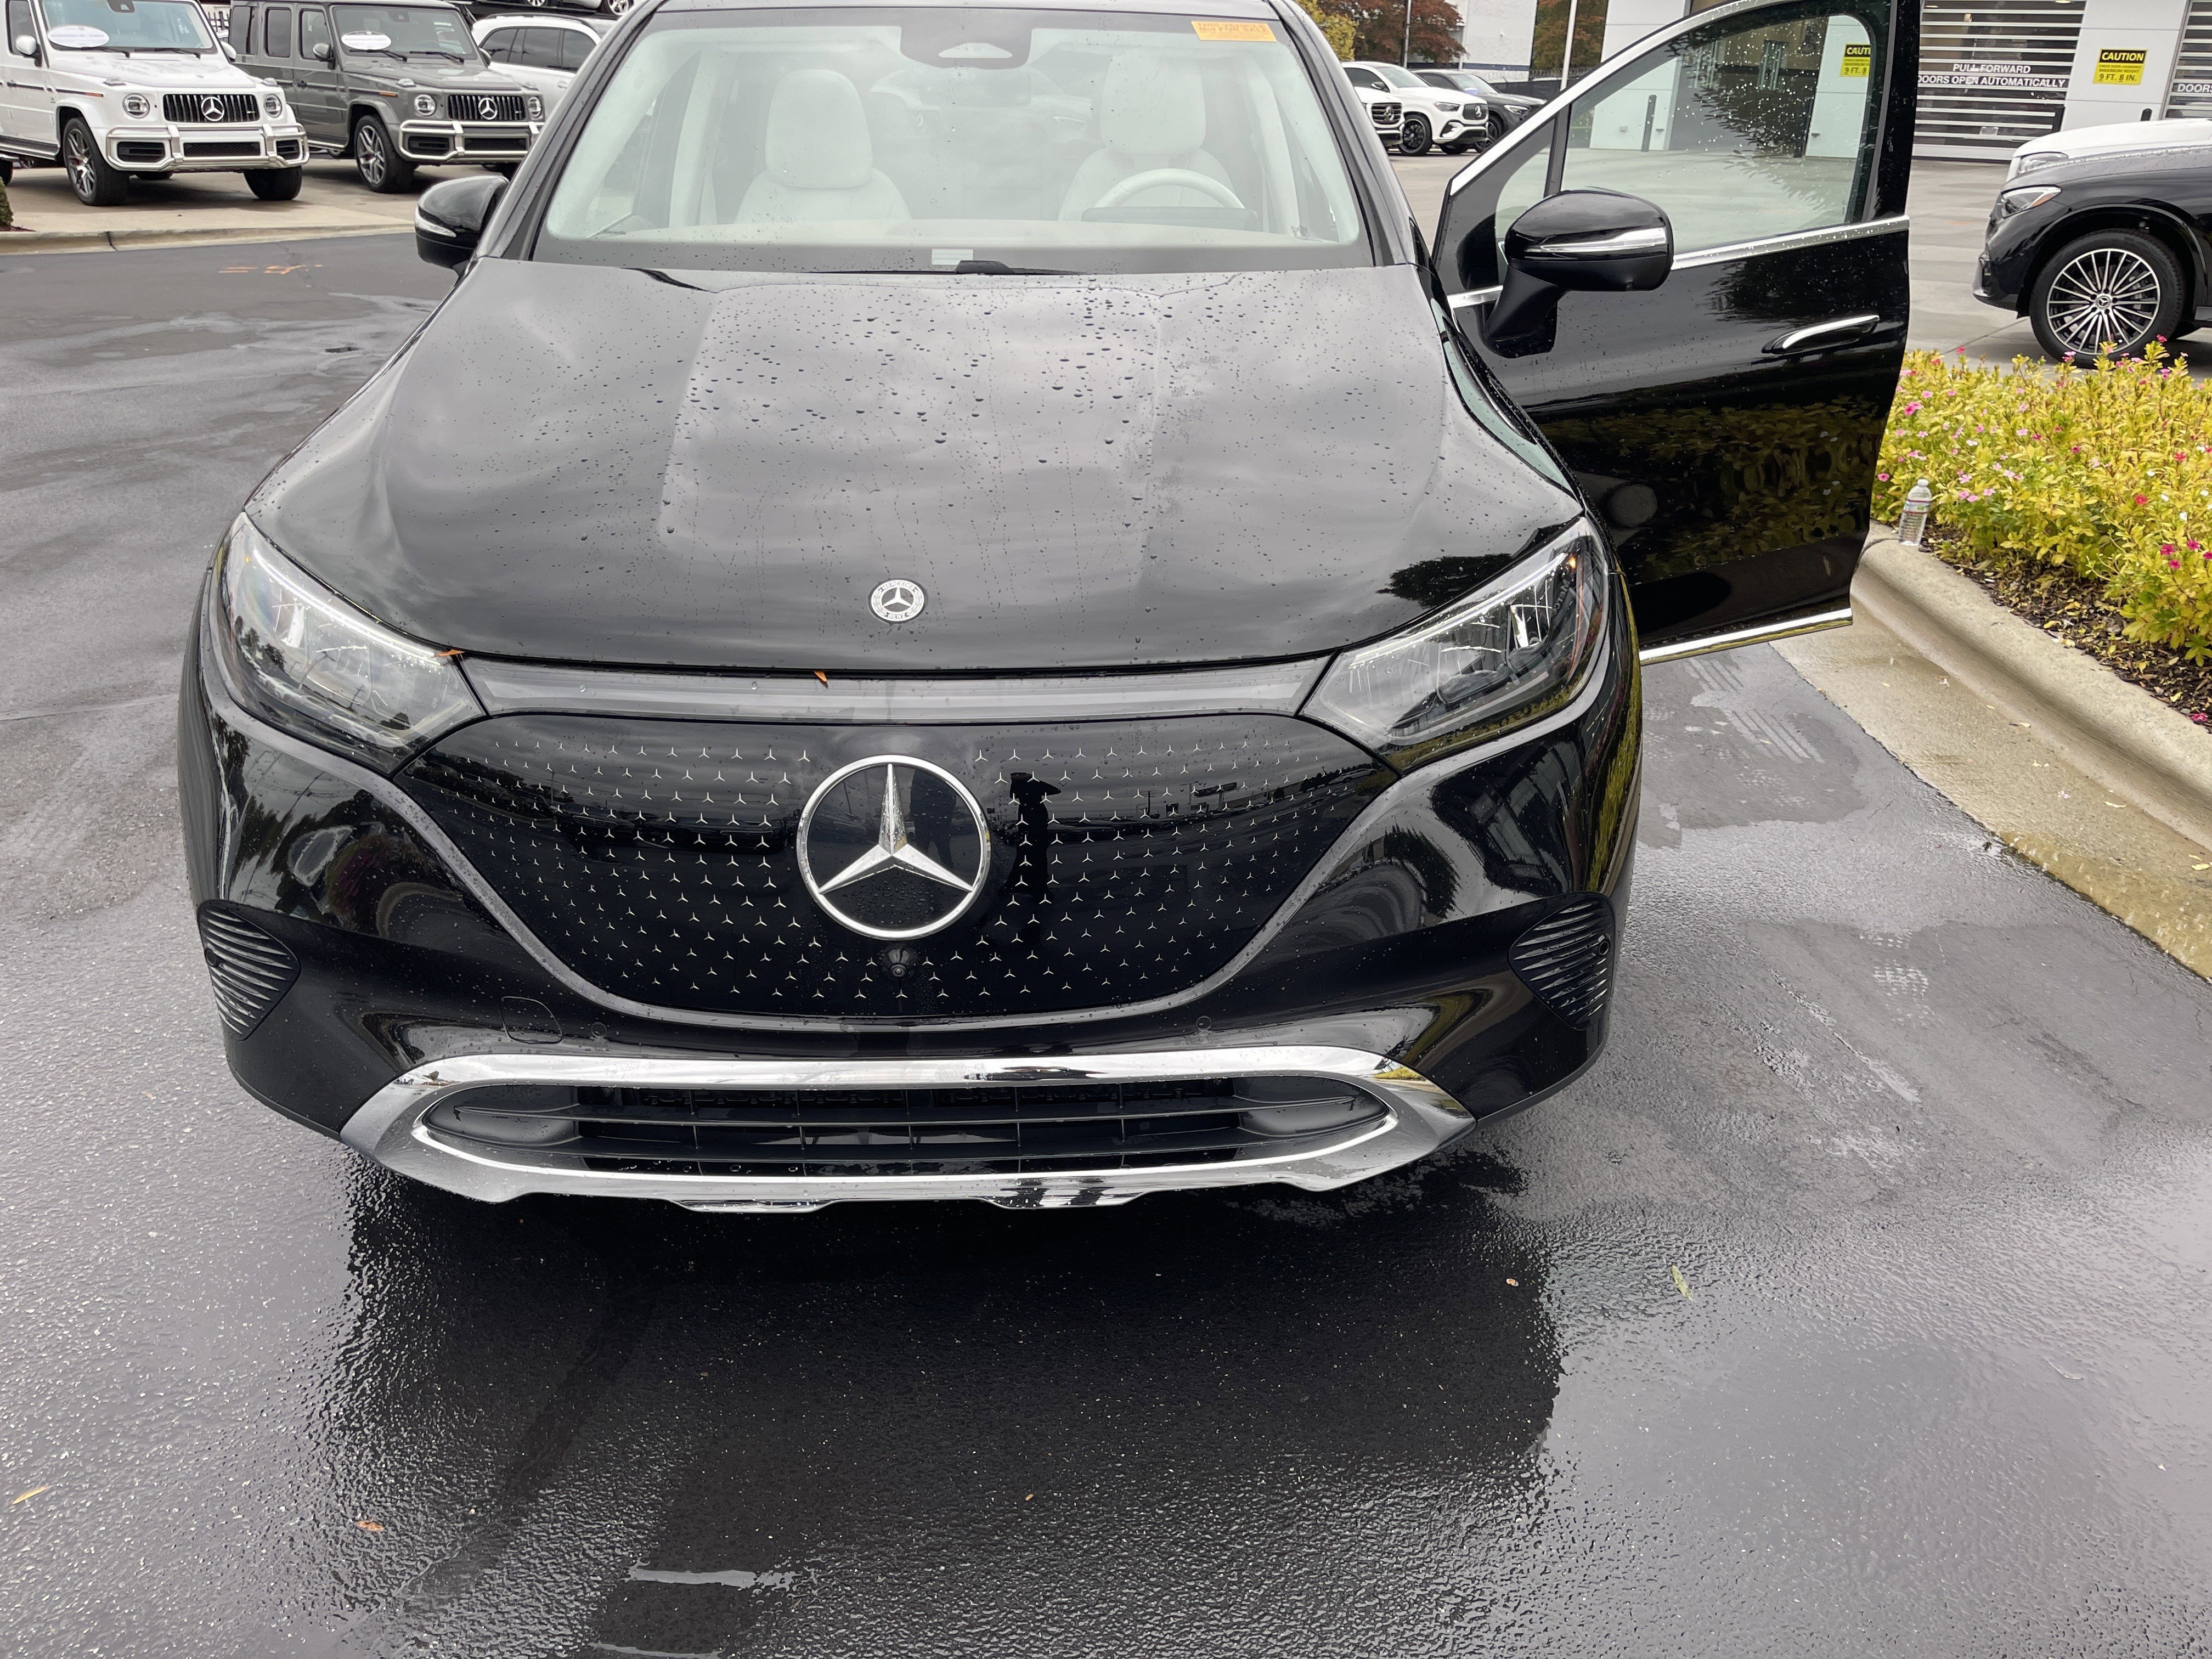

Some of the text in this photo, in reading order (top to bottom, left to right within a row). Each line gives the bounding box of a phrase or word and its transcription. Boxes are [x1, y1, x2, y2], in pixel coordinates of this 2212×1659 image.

[2102, 52, 2144, 61] CAUTION
[1953, 64, 2031, 74] PULL FORWARD
[1951, 76, 1979, 84] OPEN
[1980, 77, 2066, 87] AUTOMATICALLY
